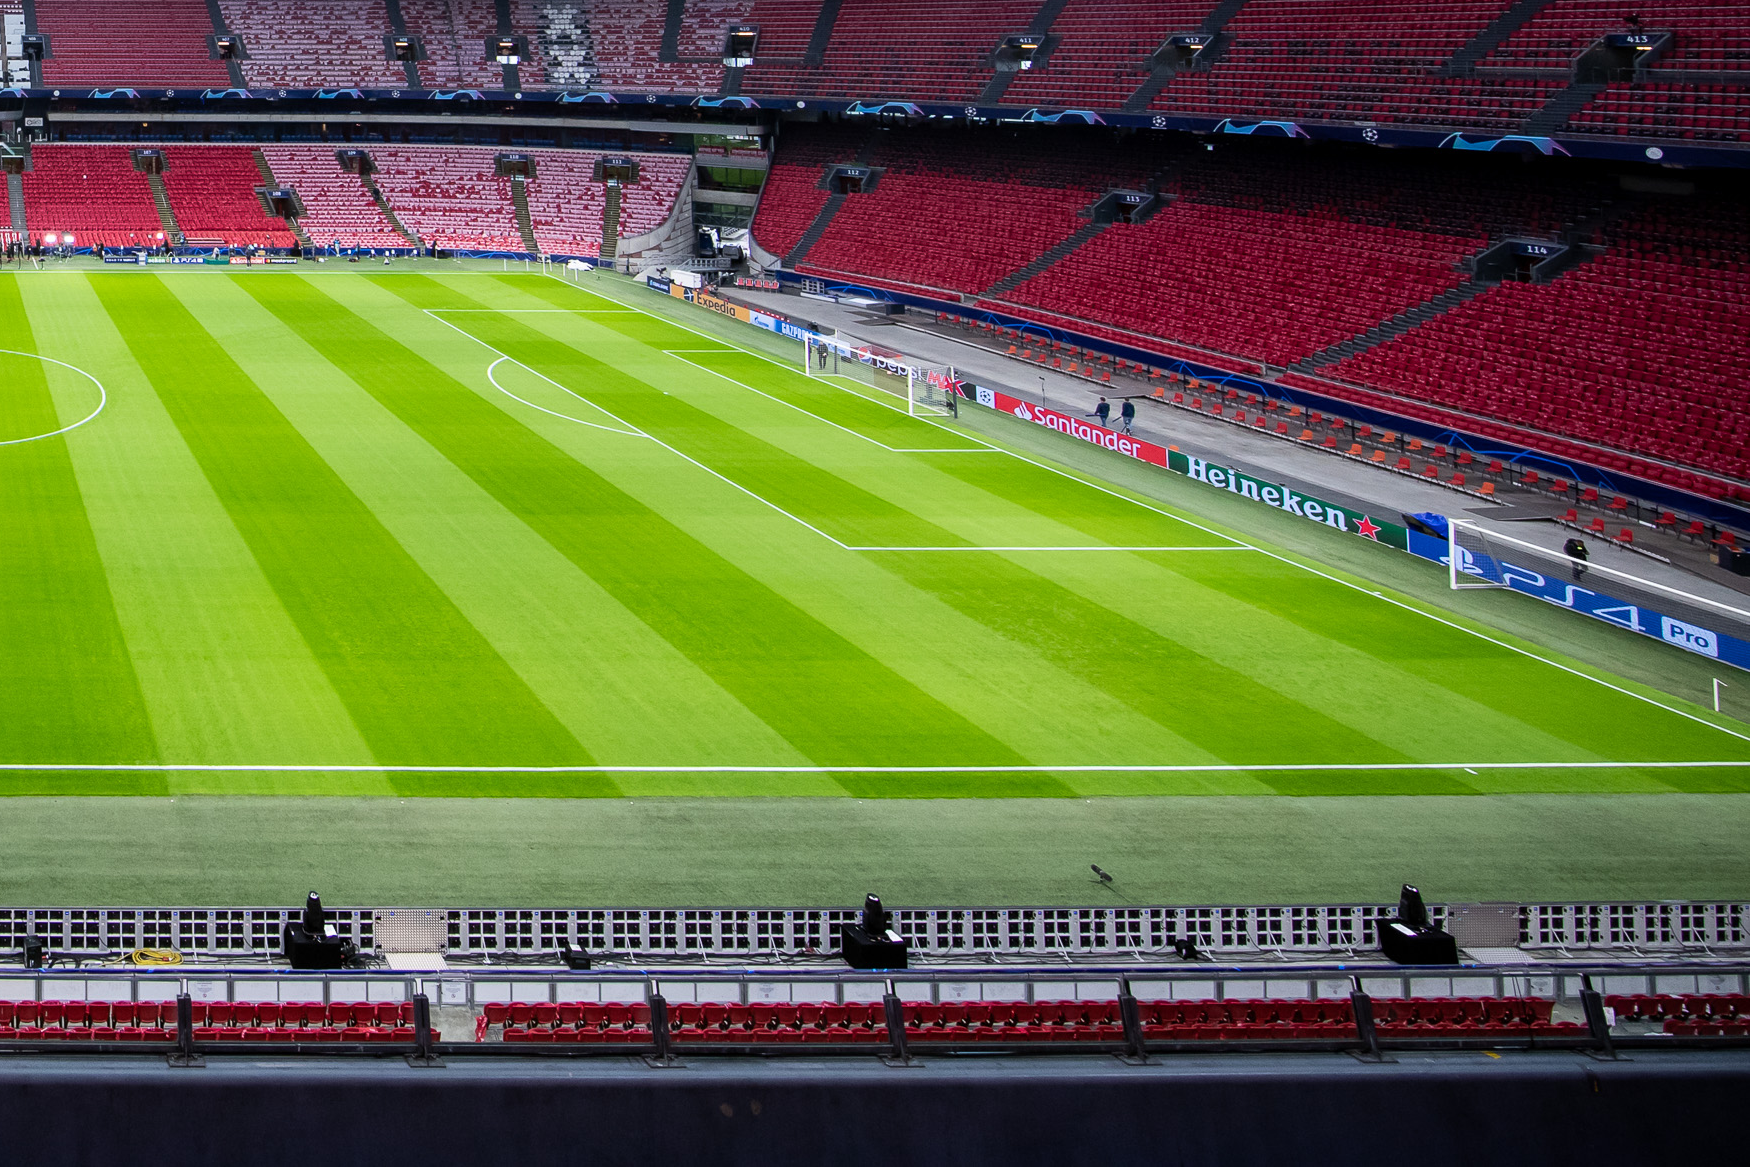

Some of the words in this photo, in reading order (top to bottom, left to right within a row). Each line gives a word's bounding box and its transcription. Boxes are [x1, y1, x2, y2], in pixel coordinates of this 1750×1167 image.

[1527, 245, 1548, 254] 114
[697, 293, 735, 316] Expedia
[876, 356, 922, 380] pepsi
[927, 370, 968, 400] MAX
[1034, 406, 1140, 458] Santander
[1186, 455, 1348, 532] Heineken
[1501, 562, 1646, 631] PS4
[1670, 624, 1709, 648] Pro
